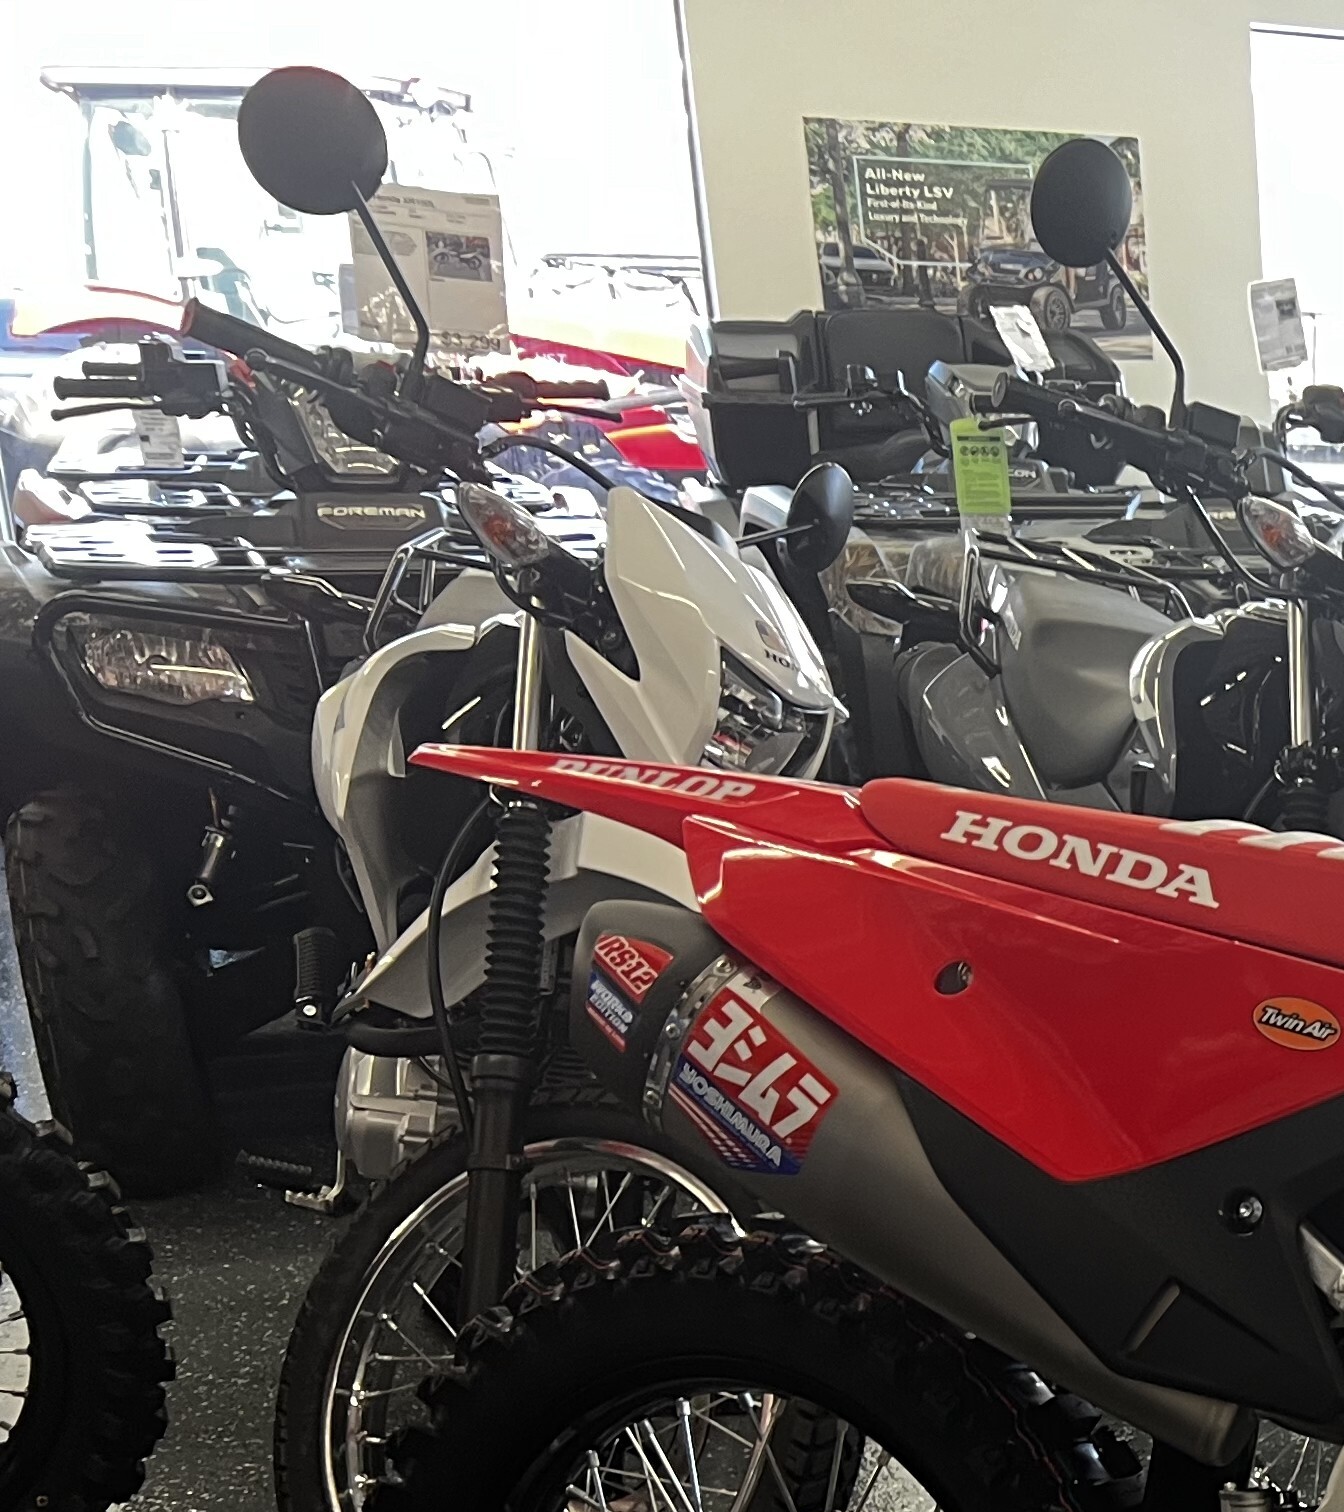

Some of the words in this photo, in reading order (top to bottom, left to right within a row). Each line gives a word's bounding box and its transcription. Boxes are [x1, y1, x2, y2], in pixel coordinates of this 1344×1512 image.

[864, 167, 925, 182] All-New
[865, 183, 920, 199] Liberty
[923, 185, 954, 199] LSV
[317, 506, 426, 519] FOREMAN
[546, 758, 757, 801] DUNLOP
[940, 809, 1221, 909] HONDA
[1261, 1007, 1306, 1033] Twin
[1301, 1021, 1337, 1040] Air
[687, 999, 832, 1139] ヨシムラ
[678, 1062, 784, 1169] YOSHIMURA
